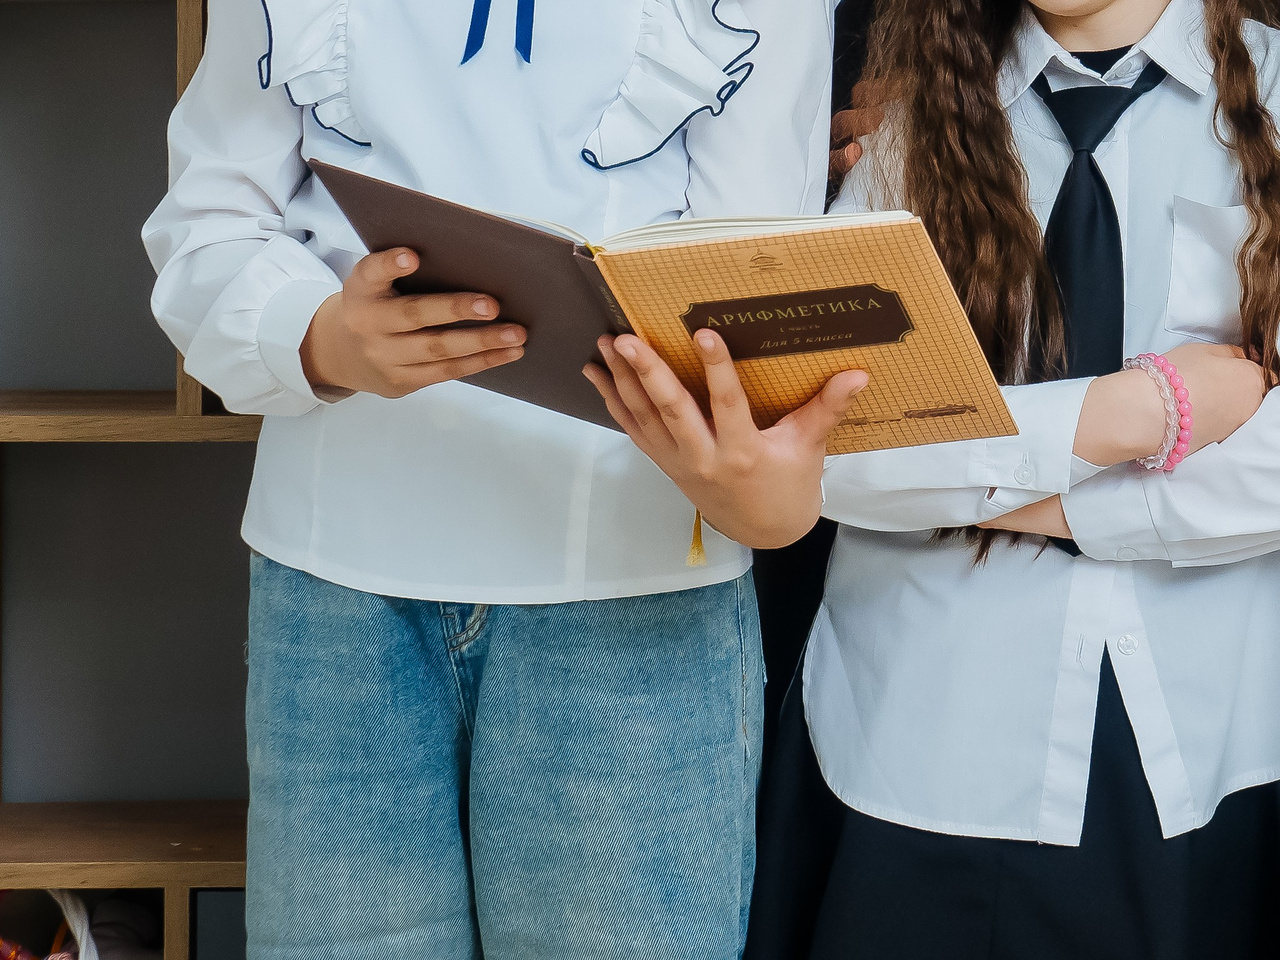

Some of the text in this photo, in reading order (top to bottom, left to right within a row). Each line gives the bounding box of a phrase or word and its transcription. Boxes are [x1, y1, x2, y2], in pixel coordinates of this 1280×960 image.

[707, 298, 882, 327] АРИФМЕТИКА
[759, 332, 853, 350] Для 5 класса
